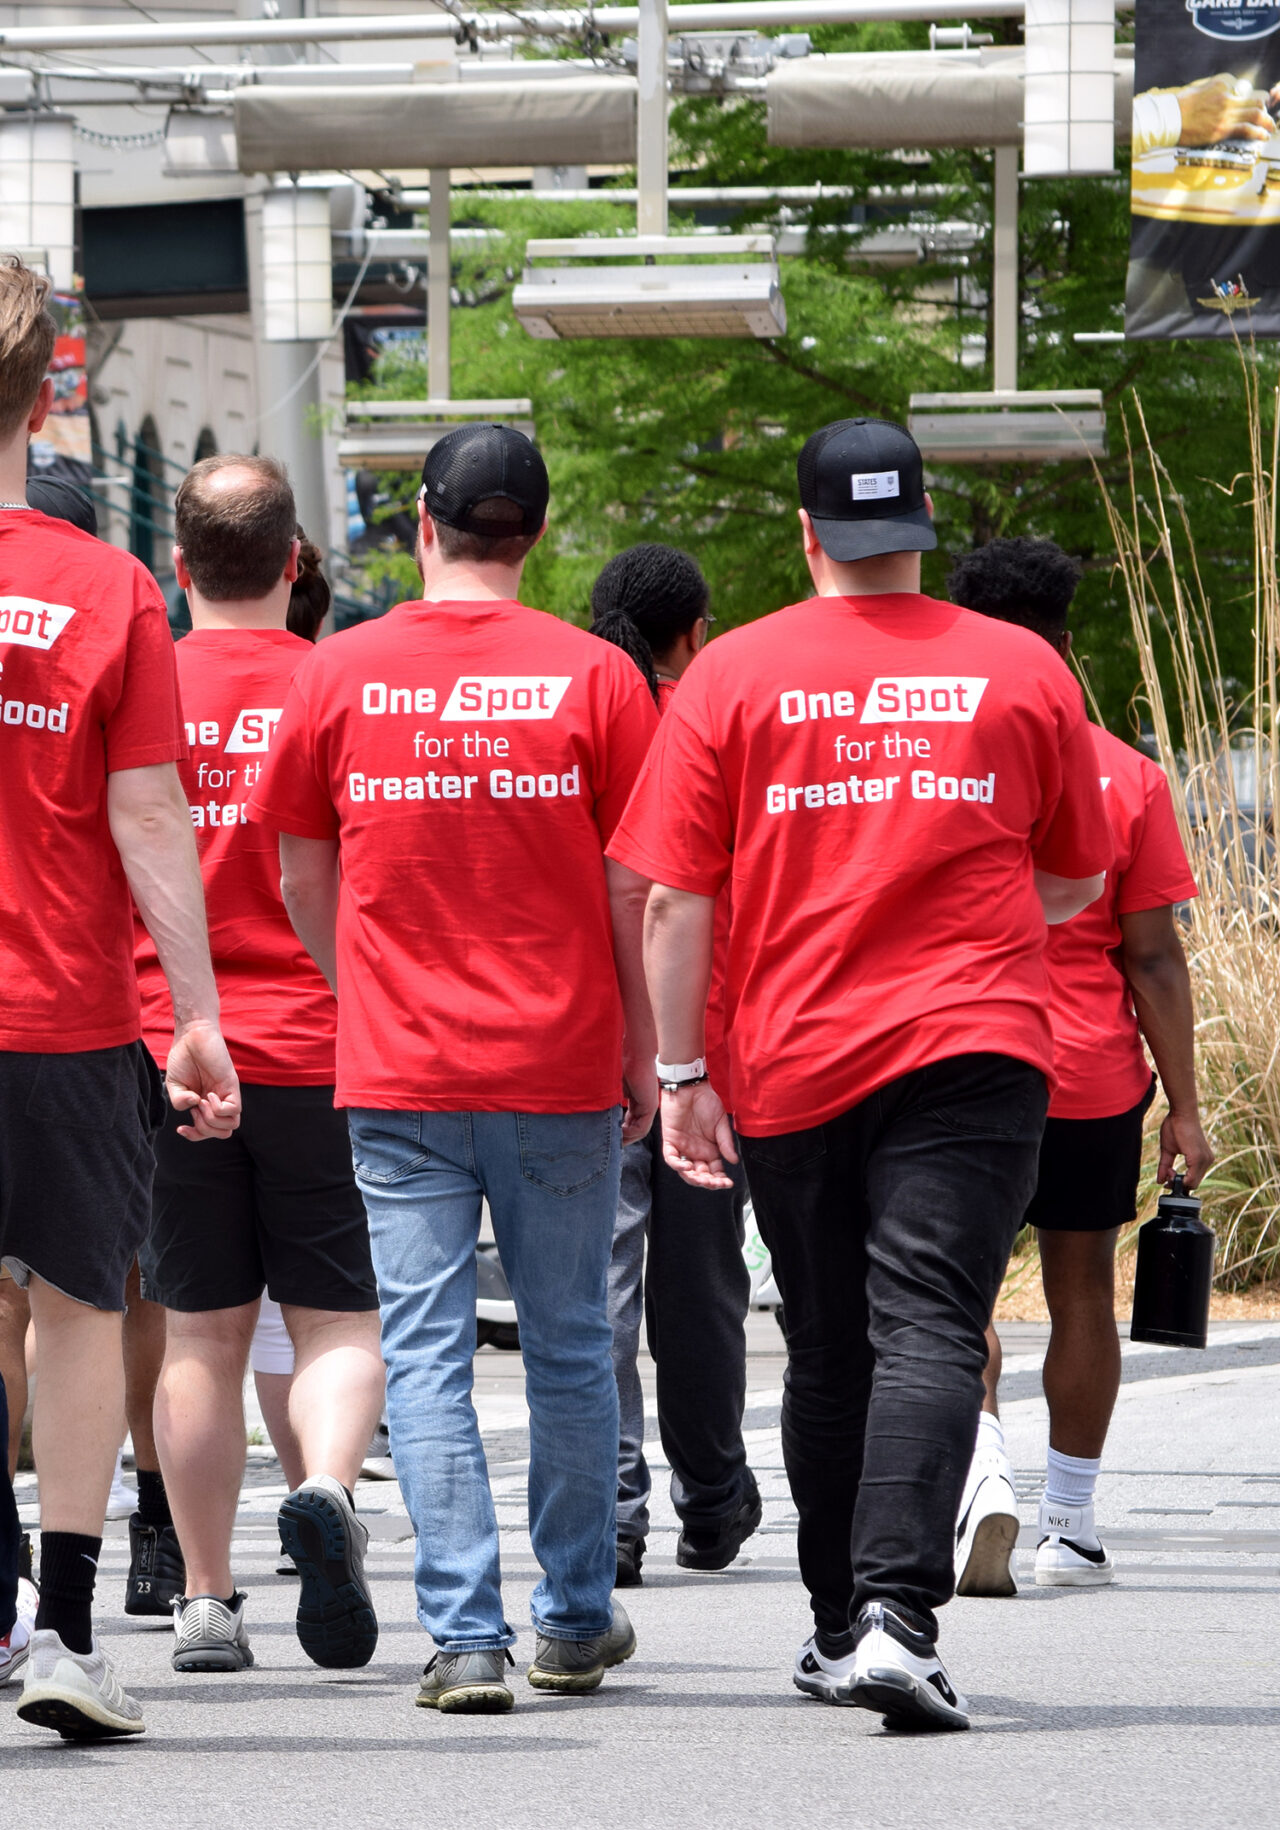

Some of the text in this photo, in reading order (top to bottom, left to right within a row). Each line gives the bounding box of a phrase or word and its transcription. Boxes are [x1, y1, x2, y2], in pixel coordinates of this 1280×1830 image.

[362, 681, 551, 719] One Spot
[779, 682, 970, 724] One Spot
[184, 720, 220, 746] ne
[413, 730, 510, 758] for the
[834, 731, 931, 762] for the
[197, 762, 237, 788] for
[348, 764, 580, 802] Greater Good
[766, 769, 996, 814] Greater Good
[1047, 1515, 1070, 1529] NIKE
[137, 1581, 151, 1594] 23
